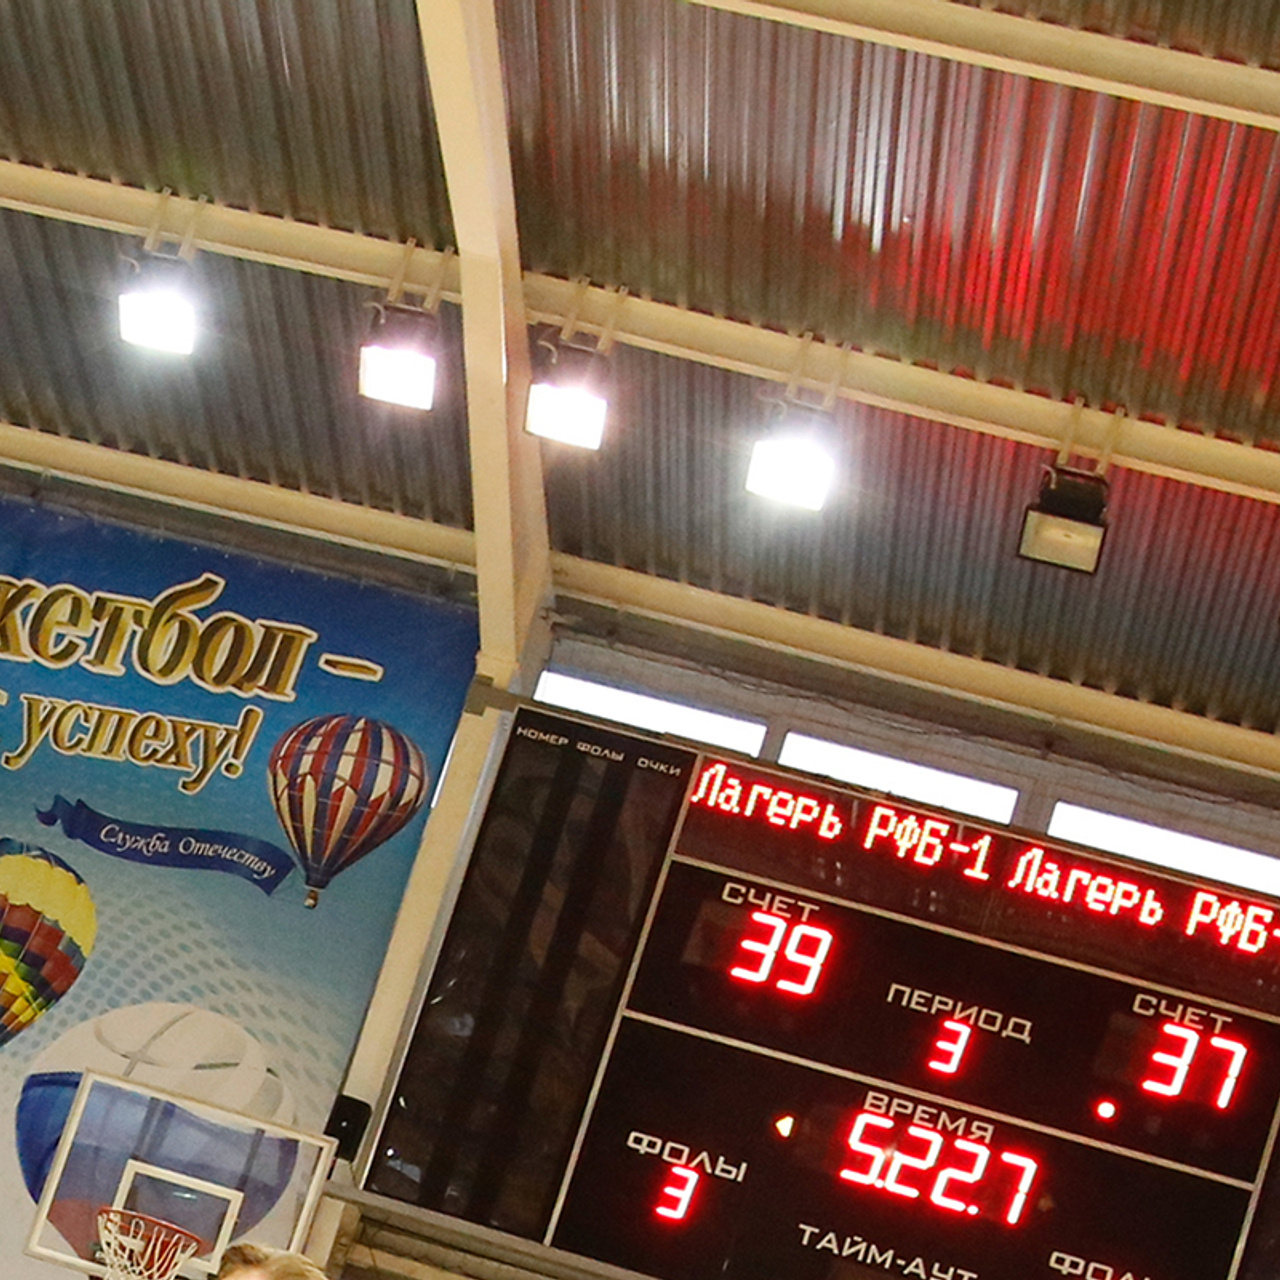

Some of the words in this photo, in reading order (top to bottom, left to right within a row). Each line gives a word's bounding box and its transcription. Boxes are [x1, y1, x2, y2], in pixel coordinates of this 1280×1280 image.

[1, 692, 263, 795] успеху!
[516, 726, 569, 746] НОМЕР
[576, 741, 625, 762] ФОЛЫ
[636, 757, 682, 777] ОЧКИ
[99, 824, 171, 856] Служба
[178, 837, 276, 879] Отечеству
[691, 762, 843, 840] Лагерь
[864, 805, 992, 882] РФБ-1
[1008, 847, 1163, 925] Лагерь
[721, 881, 819, 922] СЧЕТ
[730, 911, 834, 996] 39
[886, 983, 1034, 1044] ПЕРИОД
[1132, 994, 1233, 1033] СЧЕТ
[928, 1020, 971, 1074] 3
[1142, 1023, 1248, 1109] 37
[863, 1090, 995, 1144] ВРЕМЯ
[626, 1130, 748, 1184] ФОЛЫ
[655, 1166, 699, 1220] 3
